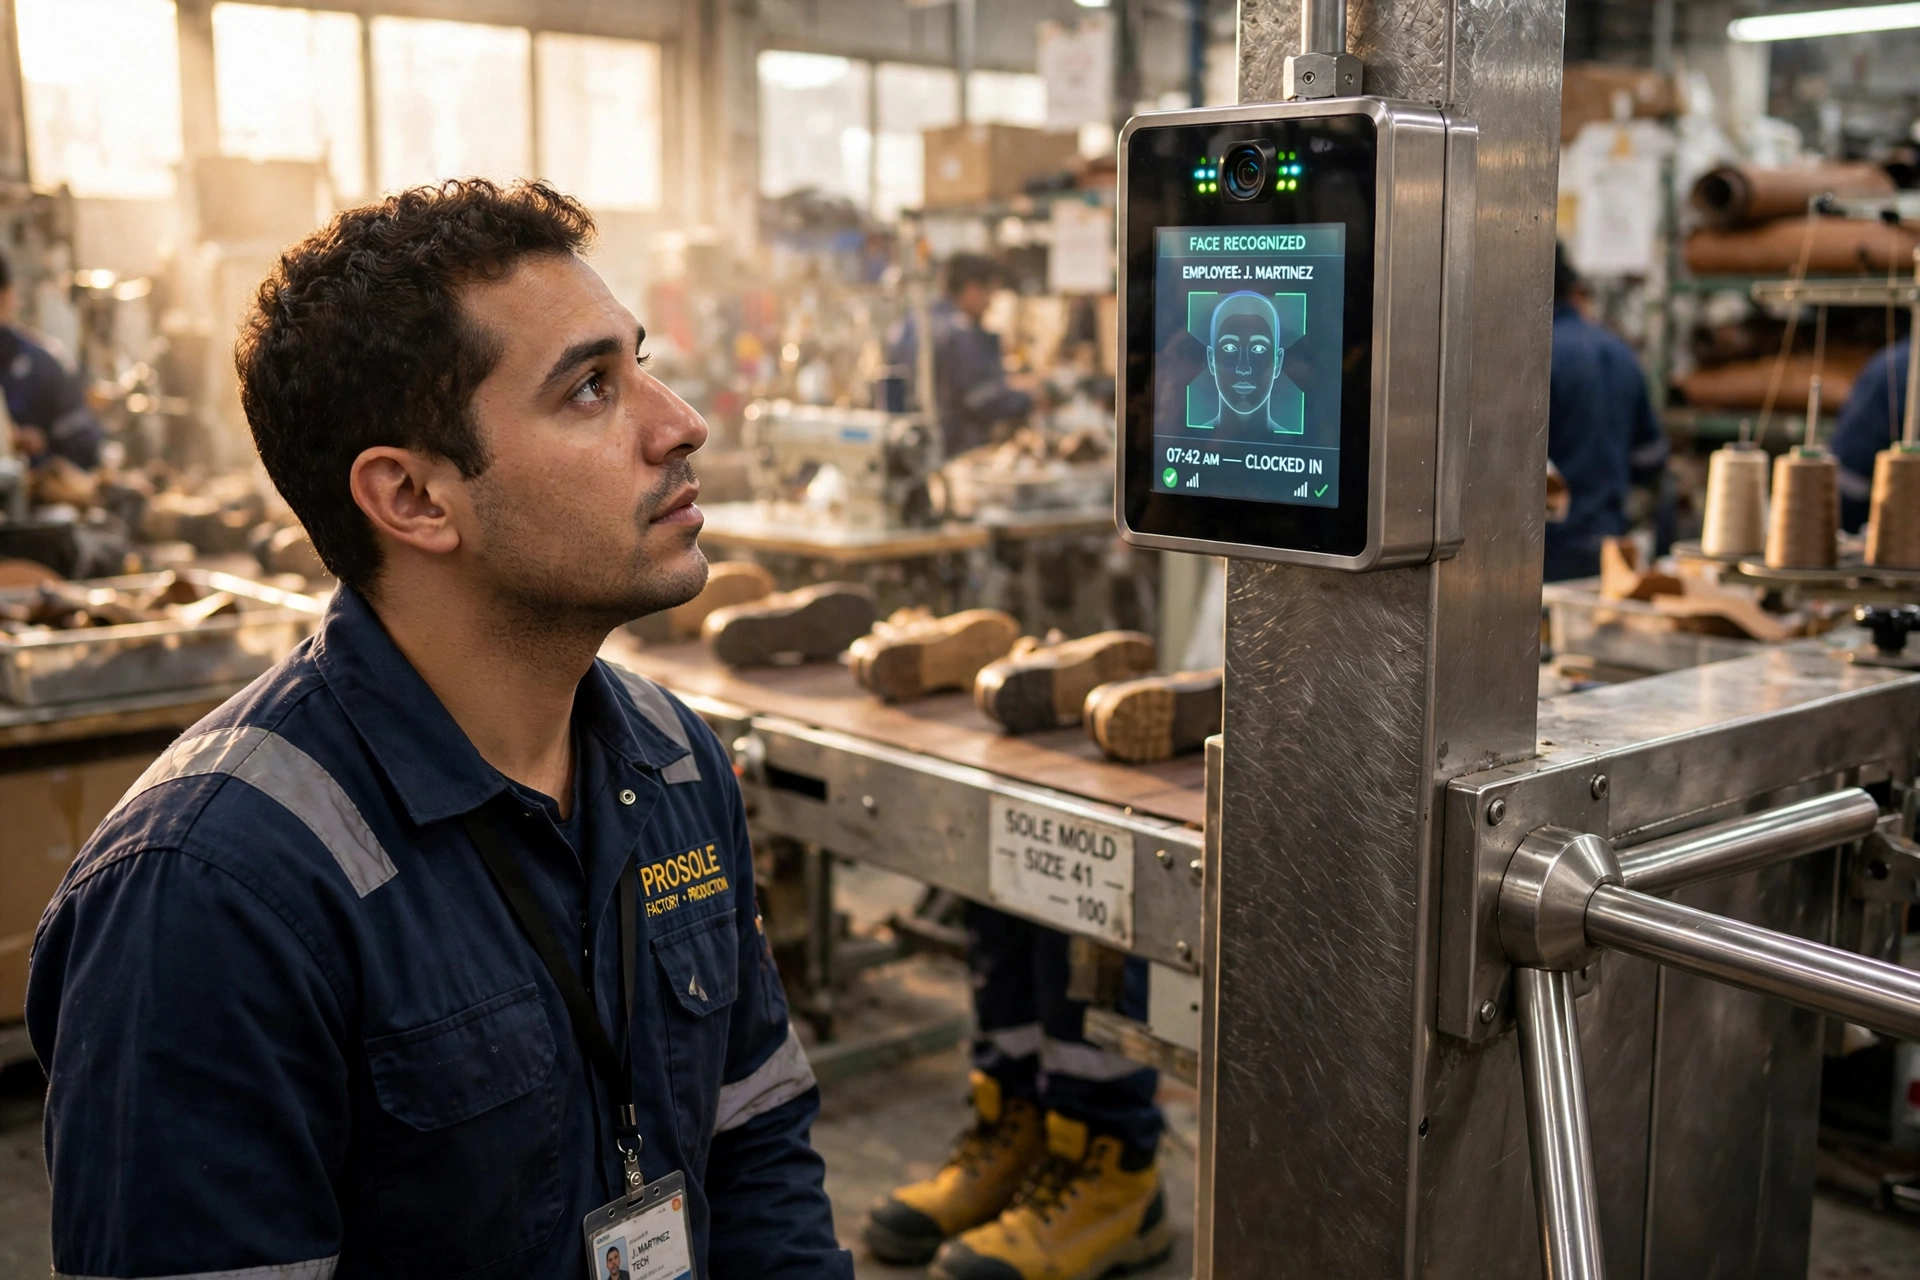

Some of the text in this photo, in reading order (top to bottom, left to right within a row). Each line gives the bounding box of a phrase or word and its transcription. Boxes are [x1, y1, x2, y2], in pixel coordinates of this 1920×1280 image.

[1189, 234, 1306, 251] FACE RECOGNIZED
[1182, 265, 1314, 280] EMPLOYEE: J. MARTINEZ
[1166, 447, 1201, 465] 07:42
[1202, 453, 1220, 466] AM
[1245, 454, 1305, 474] CLOCKED
[1308, 458, 1323, 475] IN
[1006, 809, 1117, 861] SOLE MOLD
[640, 844, 721, 897] PROSOLE
[1025, 847, 1065, 881] SIZE
[1071, 863, 1093, 888] 41
[645, 893, 680, 918] FACTORY
[687, 876, 729, 903] PRODUCTION
[1076, 895, 1108, 926] 100
